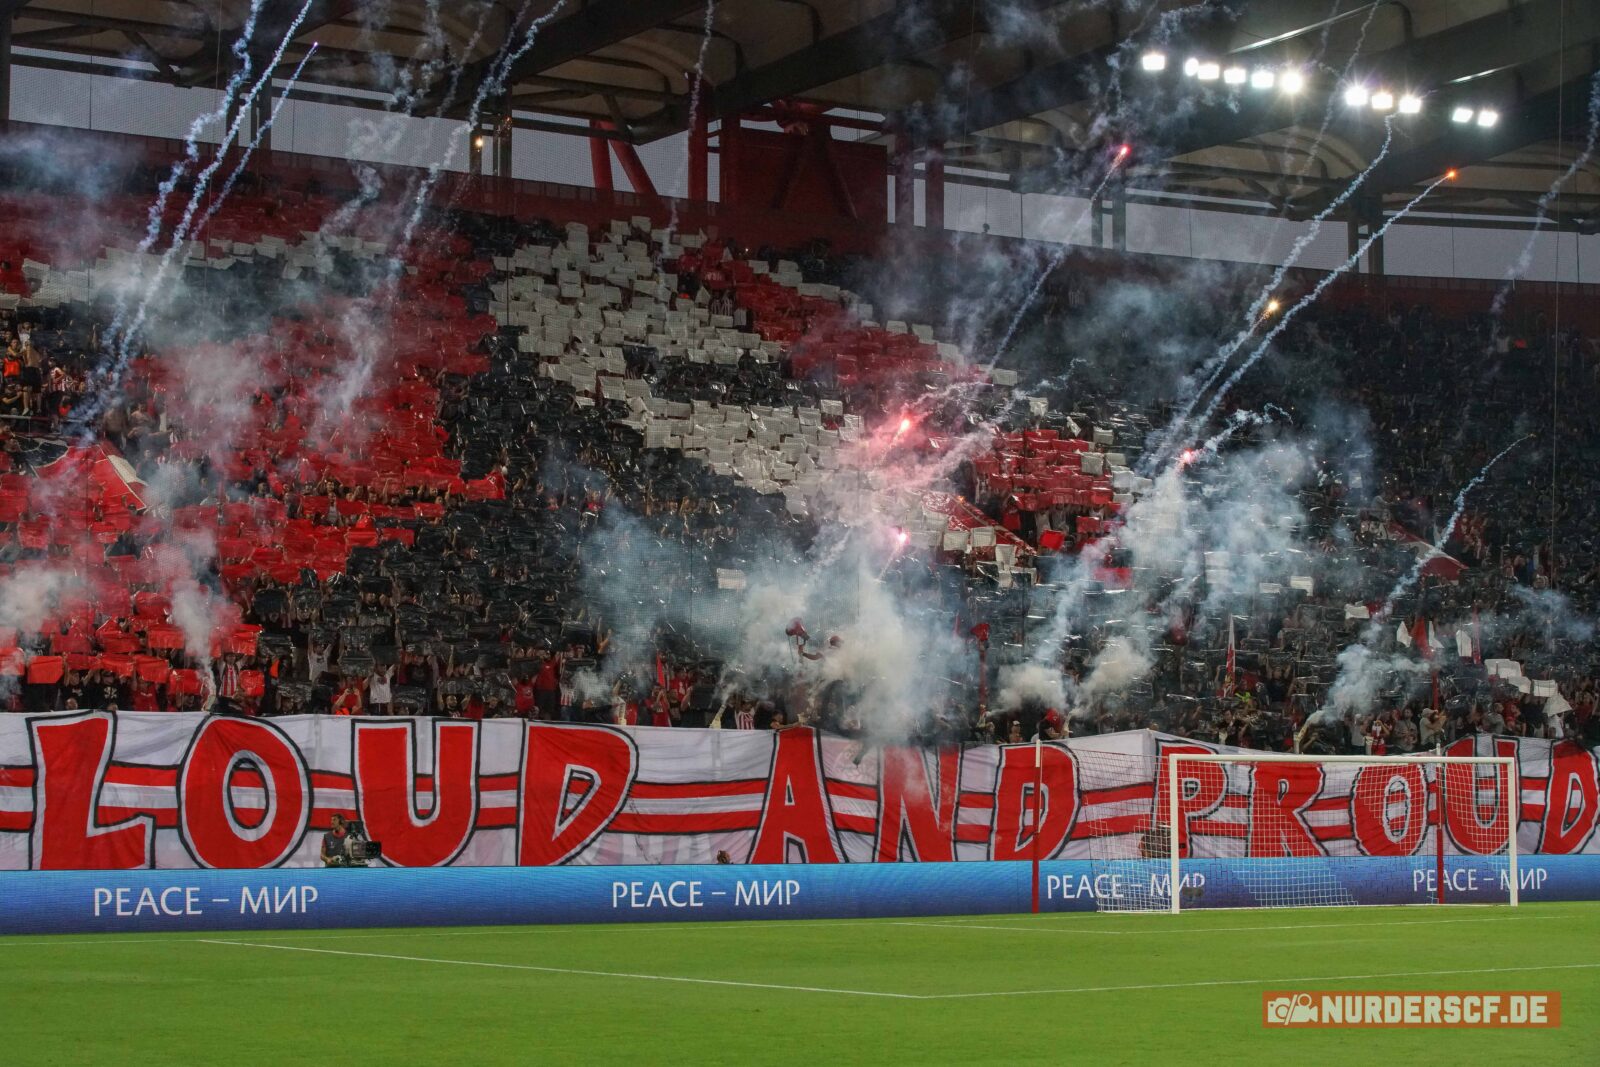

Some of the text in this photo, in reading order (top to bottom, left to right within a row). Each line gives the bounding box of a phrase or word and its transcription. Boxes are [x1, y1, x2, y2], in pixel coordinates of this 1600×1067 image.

[28, 710, 1600, 870] LOUD AND PROUD
[613, 881, 704, 908] PEACE
[734, 879, 800, 906] МИР
[1047, 873, 1125, 899] PEACE
[1413, 868, 1478, 892] PEACE
[94, 887, 202, 916] PEACE
[240, 885, 318, 914] МИР
